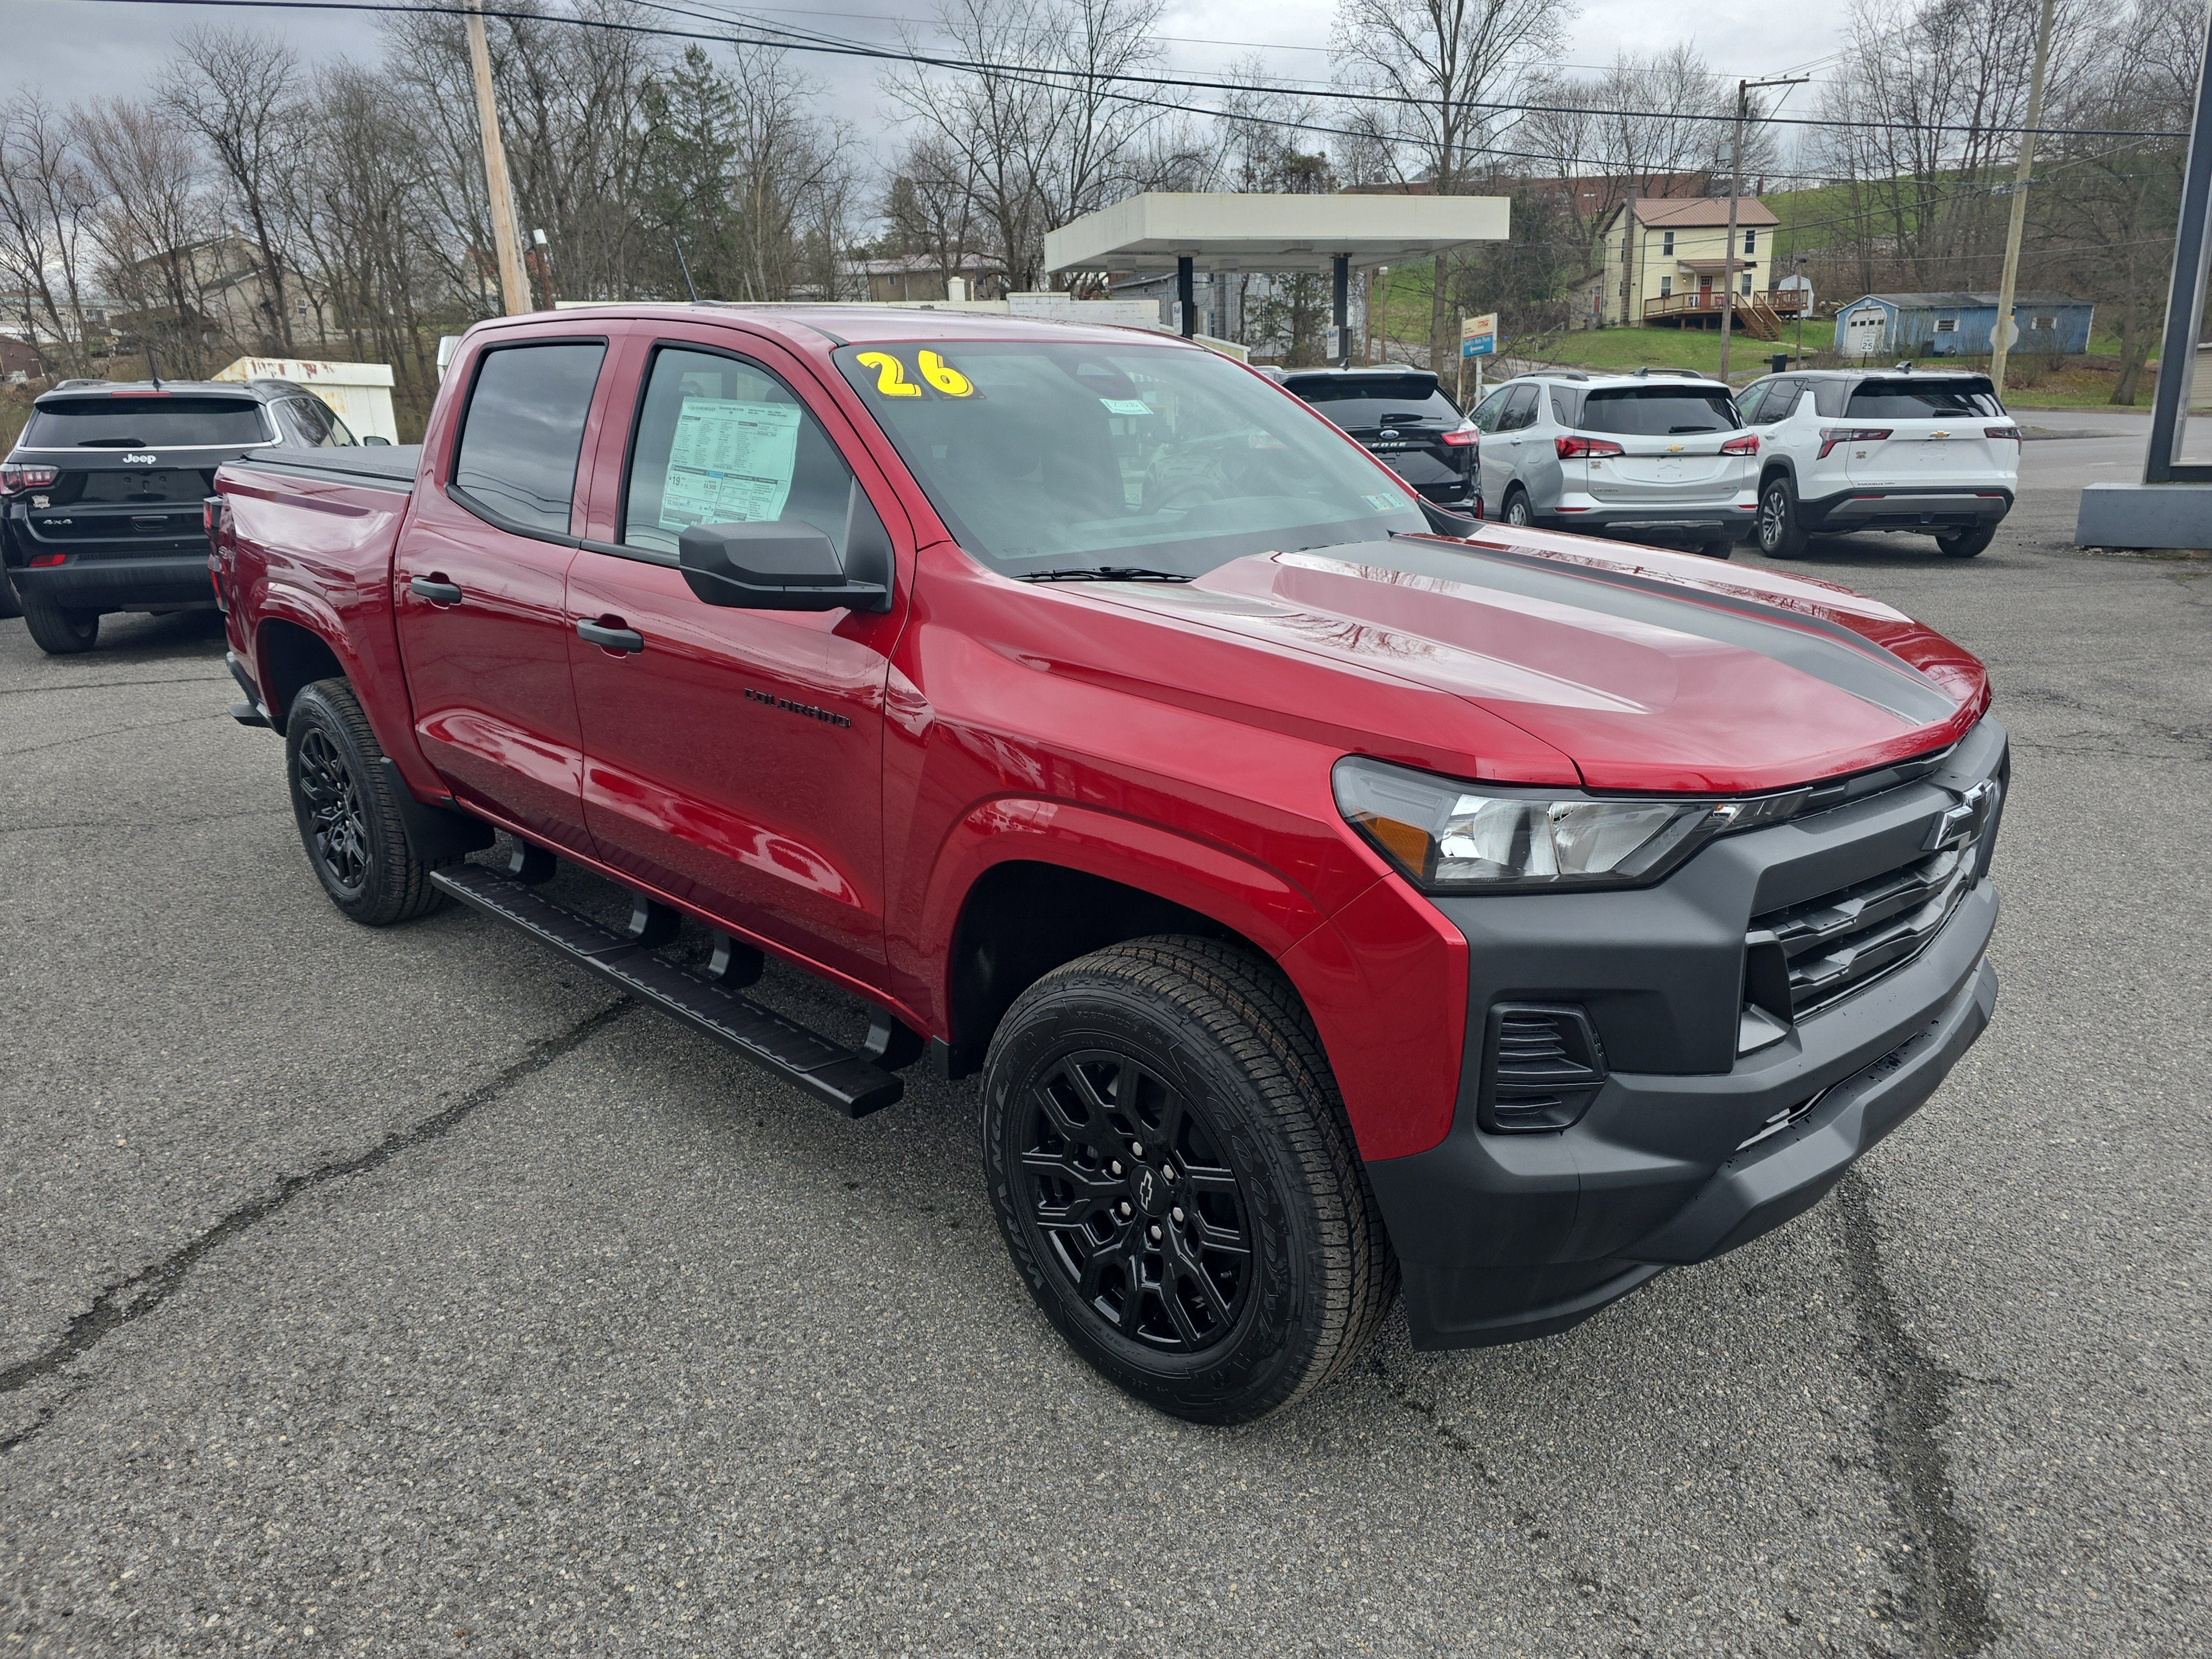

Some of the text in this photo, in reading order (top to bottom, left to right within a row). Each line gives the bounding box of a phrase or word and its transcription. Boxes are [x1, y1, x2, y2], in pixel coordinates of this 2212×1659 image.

[856, 350, 974, 397] 26
[123, 453, 157, 465] Jeep
[672, 476, 680, 486] 19
[744, 687, 851, 729] COLORADO
